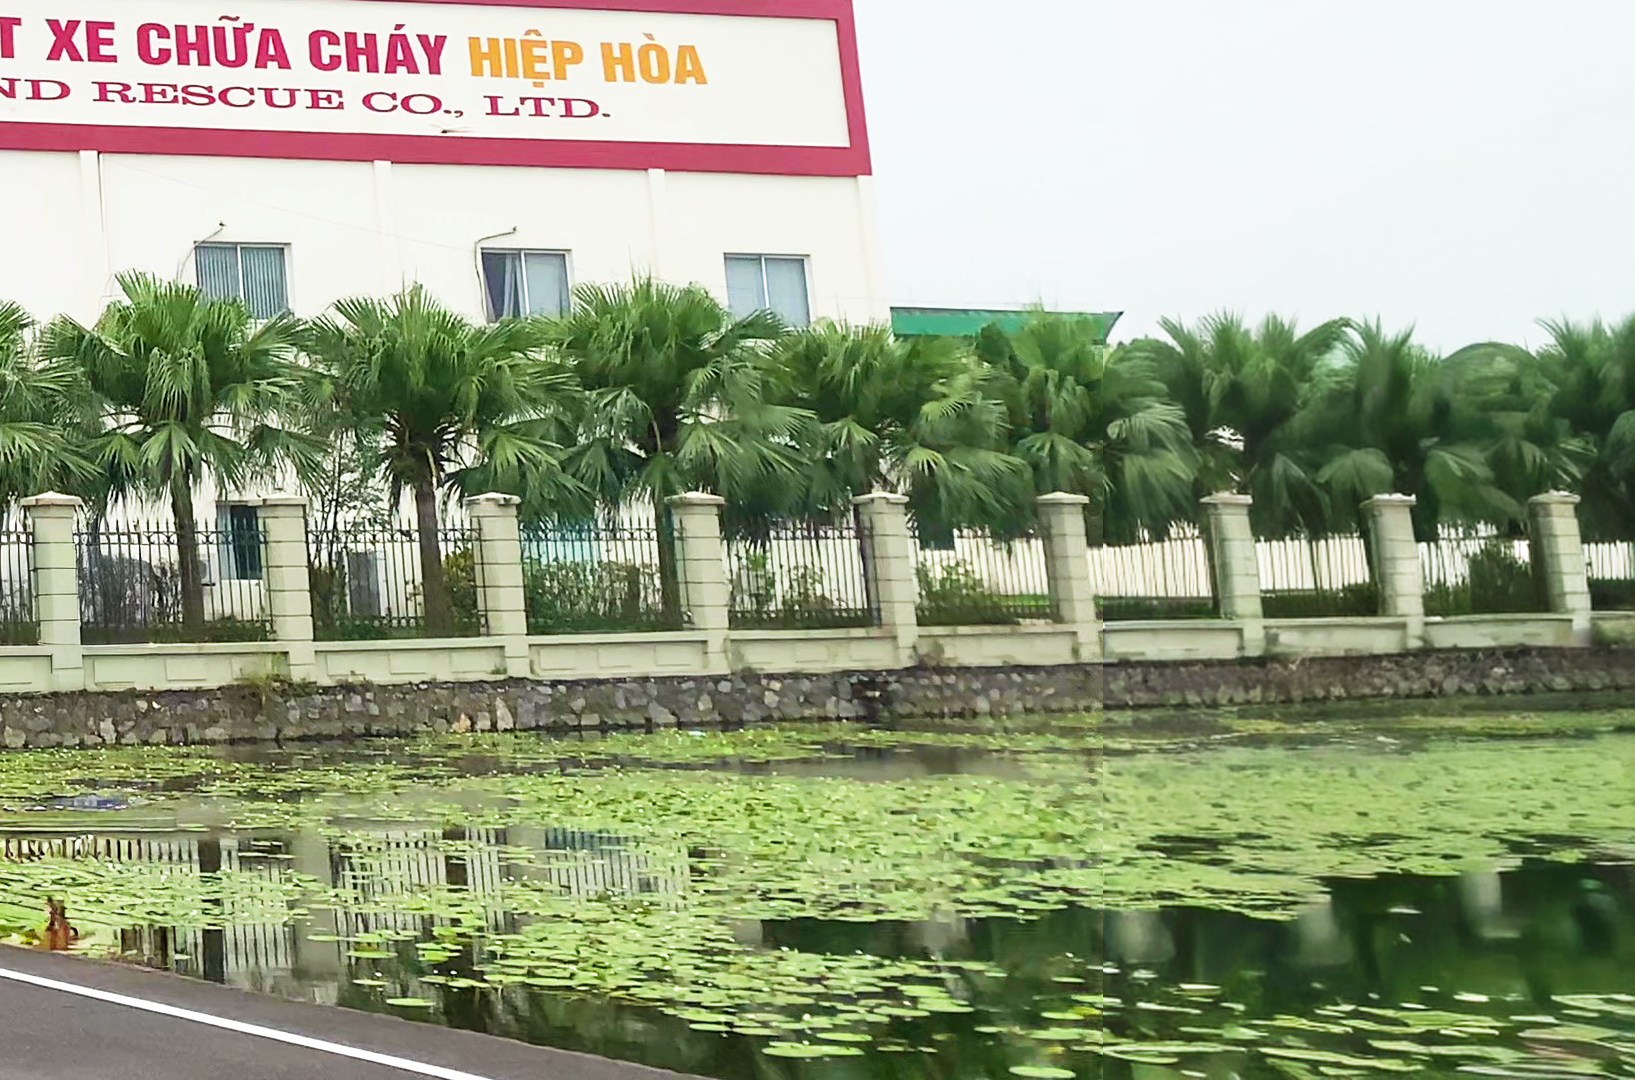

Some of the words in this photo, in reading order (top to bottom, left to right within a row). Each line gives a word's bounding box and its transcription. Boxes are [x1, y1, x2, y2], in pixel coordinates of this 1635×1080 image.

[47, 20, 117, 62] XE
[137, 16, 291, 69] CHỮA
[309, 24, 447, 74] CHÁY
[468, 30, 584, 88] HIỆP
[600, 34, 707, 84] HÒA
[92, 82, 344, 109] RESCUE
[362, 92, 463, 117] CO.,
[484, 96, 611, 118] LTD.
